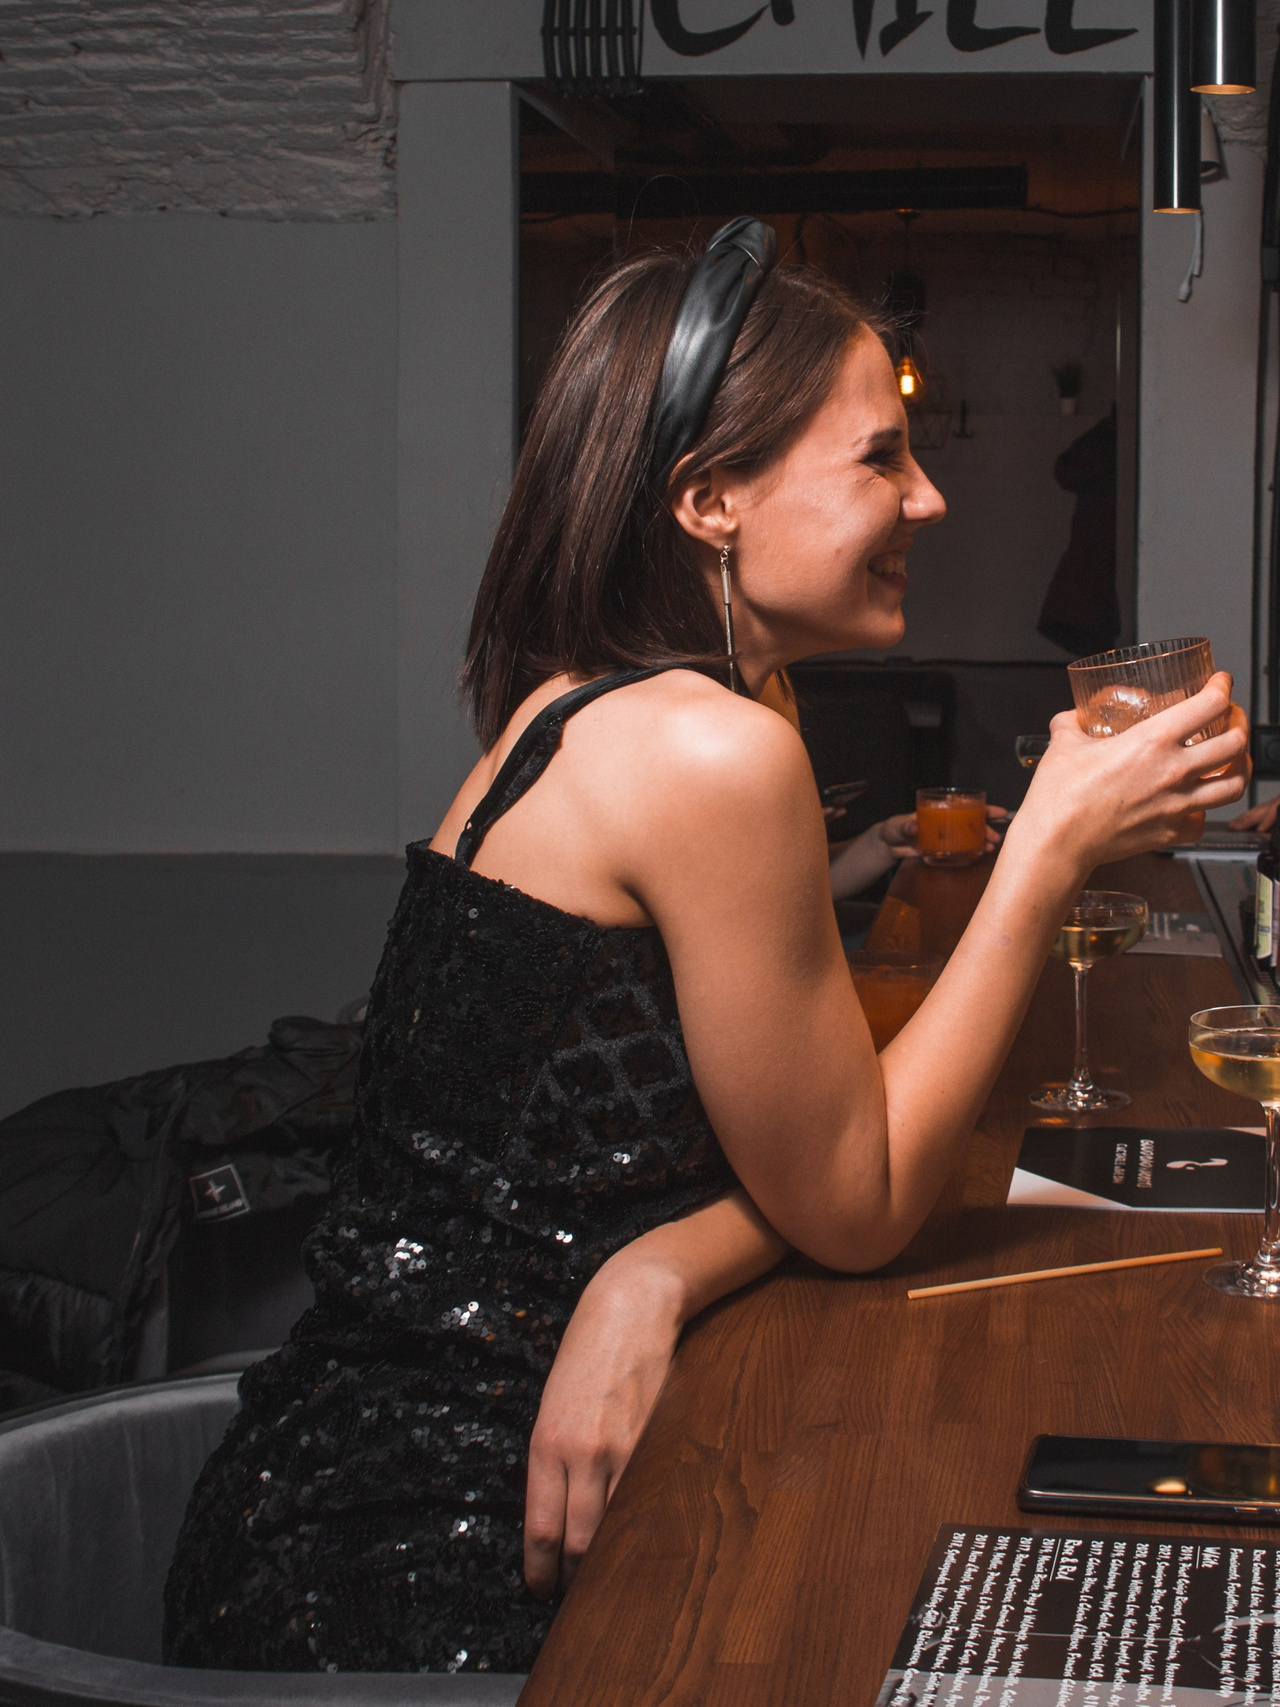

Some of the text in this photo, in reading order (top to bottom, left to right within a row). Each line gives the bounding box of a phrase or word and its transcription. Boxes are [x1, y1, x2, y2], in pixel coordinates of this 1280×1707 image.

[970, 1534, 988, 1549] 2017,
[1015, 1537, 1032, 1552] 2017,
[1061, 1539, 1082, 1555] Rose
[1087, 1540, 1103, 1556] 2017,
[1133, 1543, 1149, 1558] 2020,
[1156, 1544, 1171, 1560] 2021,
[1201, 1546, 1220, 1567] White
[1055, 1565, 1076, 1580] Red
[1086, 1663, 1104, 1678] USA,
